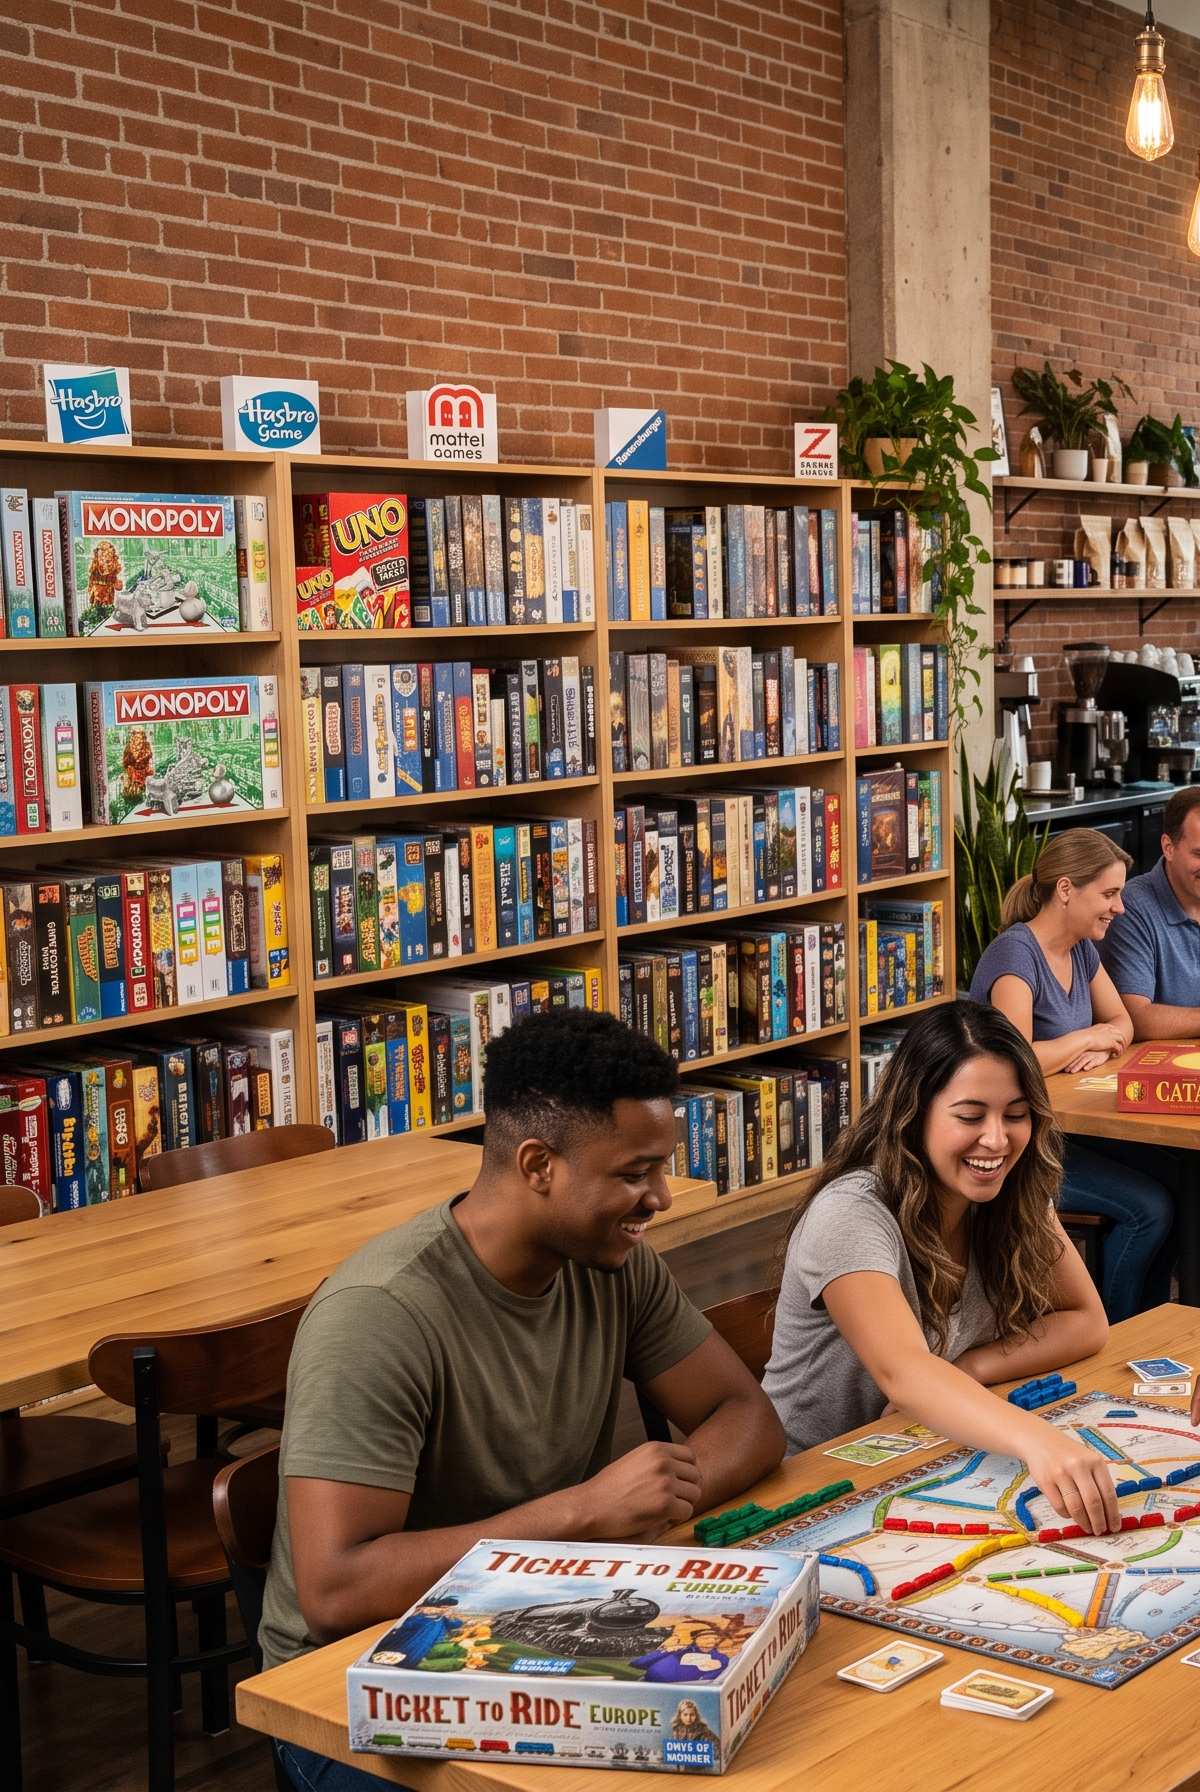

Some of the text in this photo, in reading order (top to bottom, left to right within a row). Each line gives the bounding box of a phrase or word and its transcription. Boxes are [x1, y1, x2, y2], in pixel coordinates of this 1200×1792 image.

[50, 387, 123, 412] Hasbro
[238, 398, 315, 428] Hasbro
[258, 425, 303, 441] Game
[430, 432, 484, 447] mattel
[87, 506, 221, 533] MONOPOLY
[331, 498, 406, 556] UNO
[296, 569, 334, 602] UNO
[120, 689, 246, 719] MONOPOLY
[485, 1550, 779, 1583] TICKET TO RIDE
[666, 1581, 767, 1595] EUROPE
[727, 1597, 803, 1729] TICKET TO RIDE
[362, 1684, 662, 1729] TICKET TO RIDE EUROPE
[696, 1743, 710, 1752] OF
